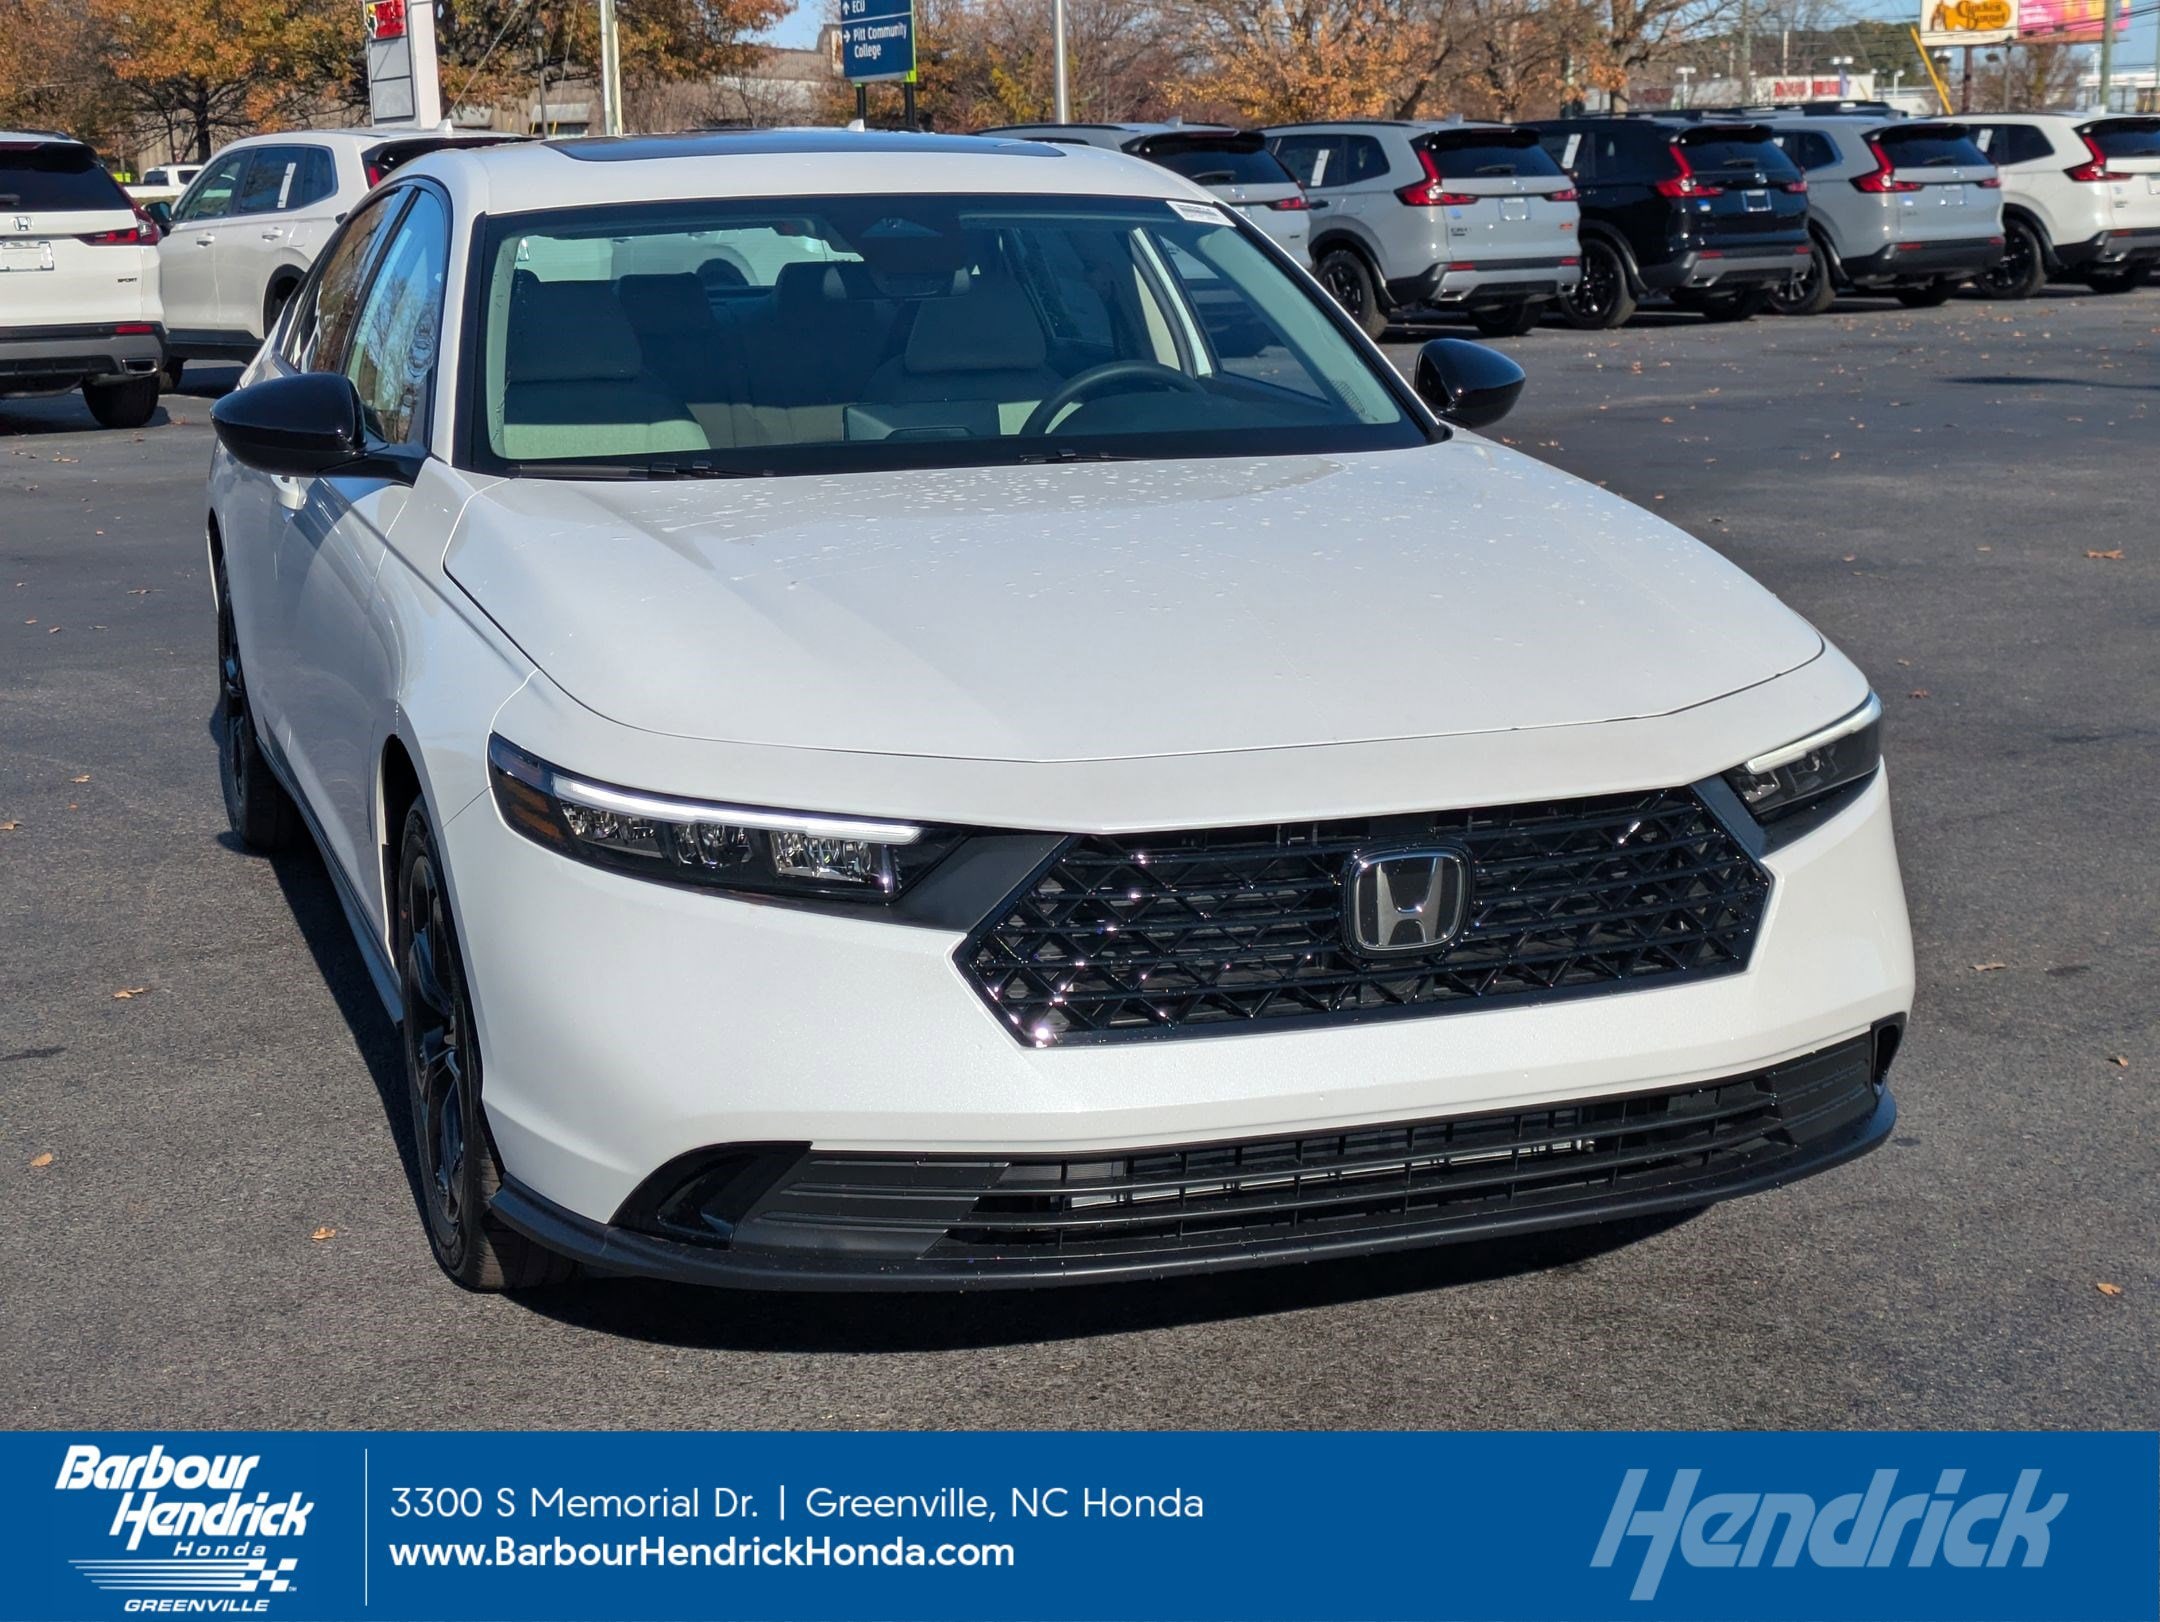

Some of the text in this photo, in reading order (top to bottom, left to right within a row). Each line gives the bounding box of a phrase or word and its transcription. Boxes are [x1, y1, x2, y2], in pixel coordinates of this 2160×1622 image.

[852, 0, 866, 13] ECU
[853, 22, 907, 41] Pitt Community
[854, 43, 882, 60] College
